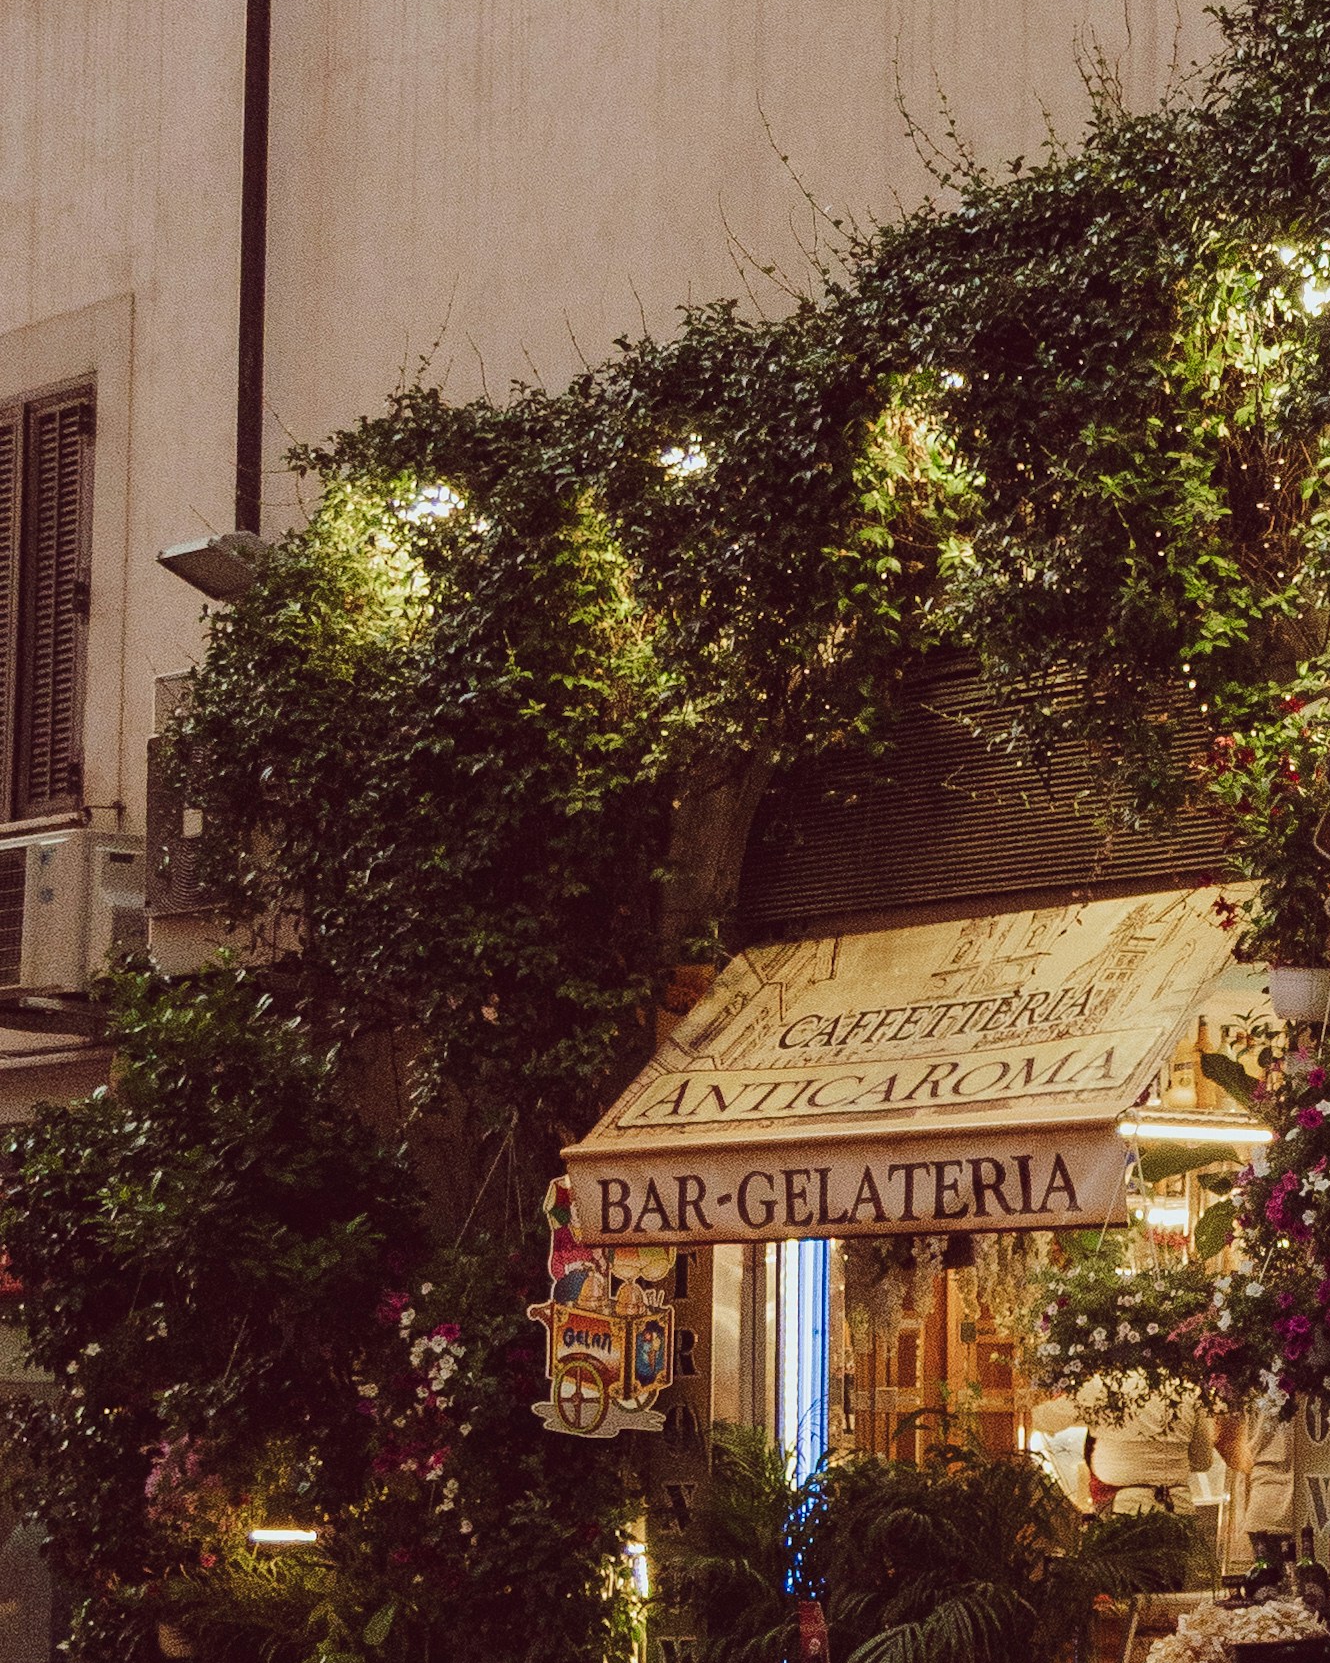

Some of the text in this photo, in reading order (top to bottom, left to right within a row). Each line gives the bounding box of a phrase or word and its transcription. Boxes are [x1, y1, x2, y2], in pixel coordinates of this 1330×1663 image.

[780, 982, 1093, 1050] CAFFETTERIA
[597, 1153, 1083, 1236] BAR-GELATERIA
[563, 1326, 612, 1354] GELATI
